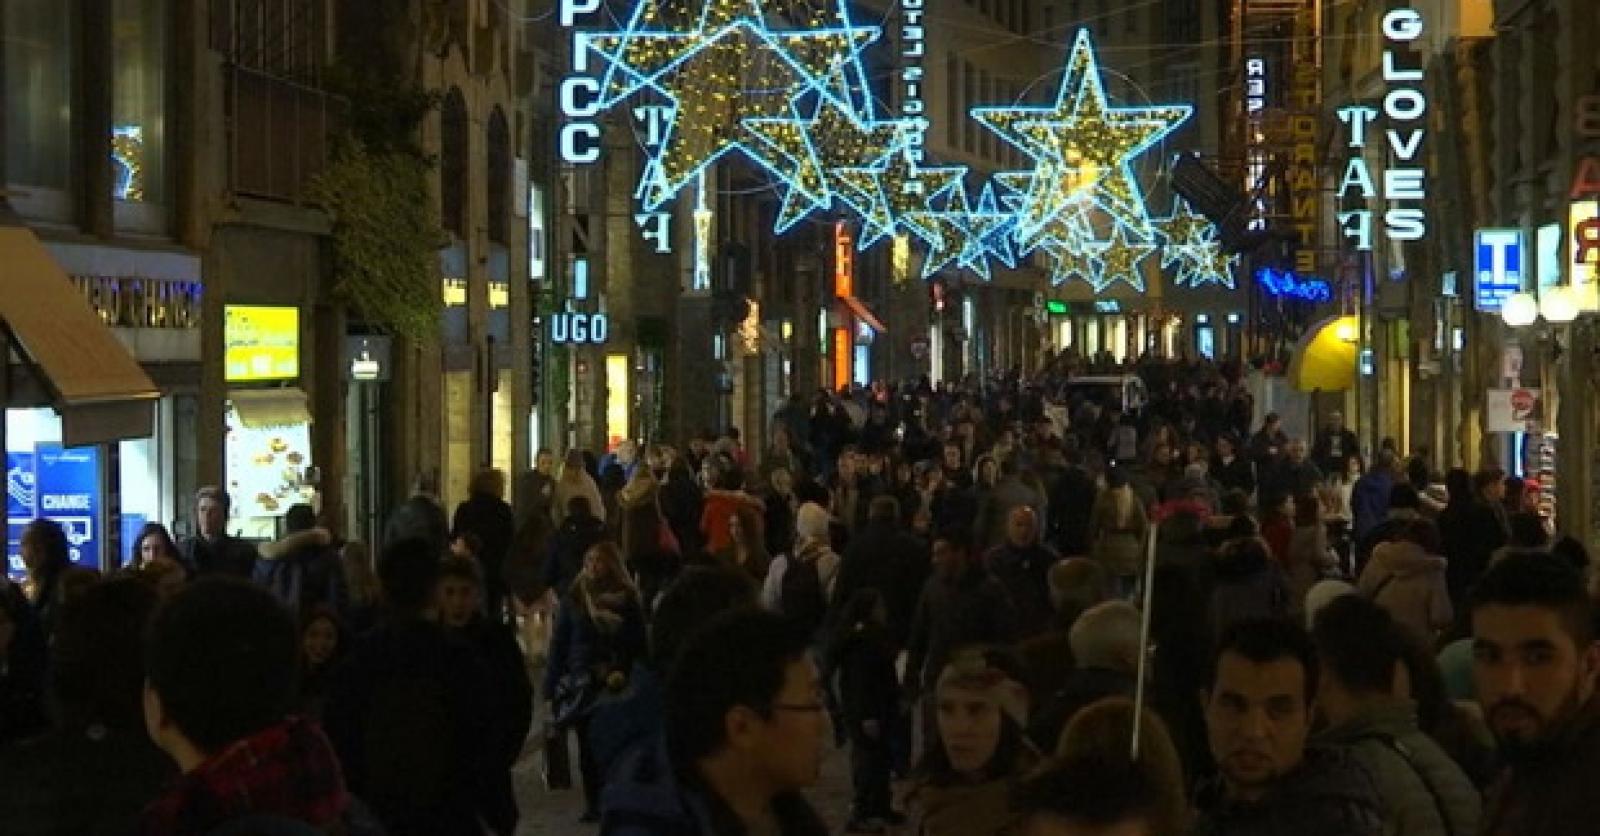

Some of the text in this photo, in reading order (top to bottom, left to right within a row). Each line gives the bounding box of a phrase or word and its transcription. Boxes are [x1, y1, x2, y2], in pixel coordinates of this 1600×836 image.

[1382, 9, 1425, 240] GLOVES
[551, 313, 607, 343] UGO
[43, 493, 90, 511] CHANGE
